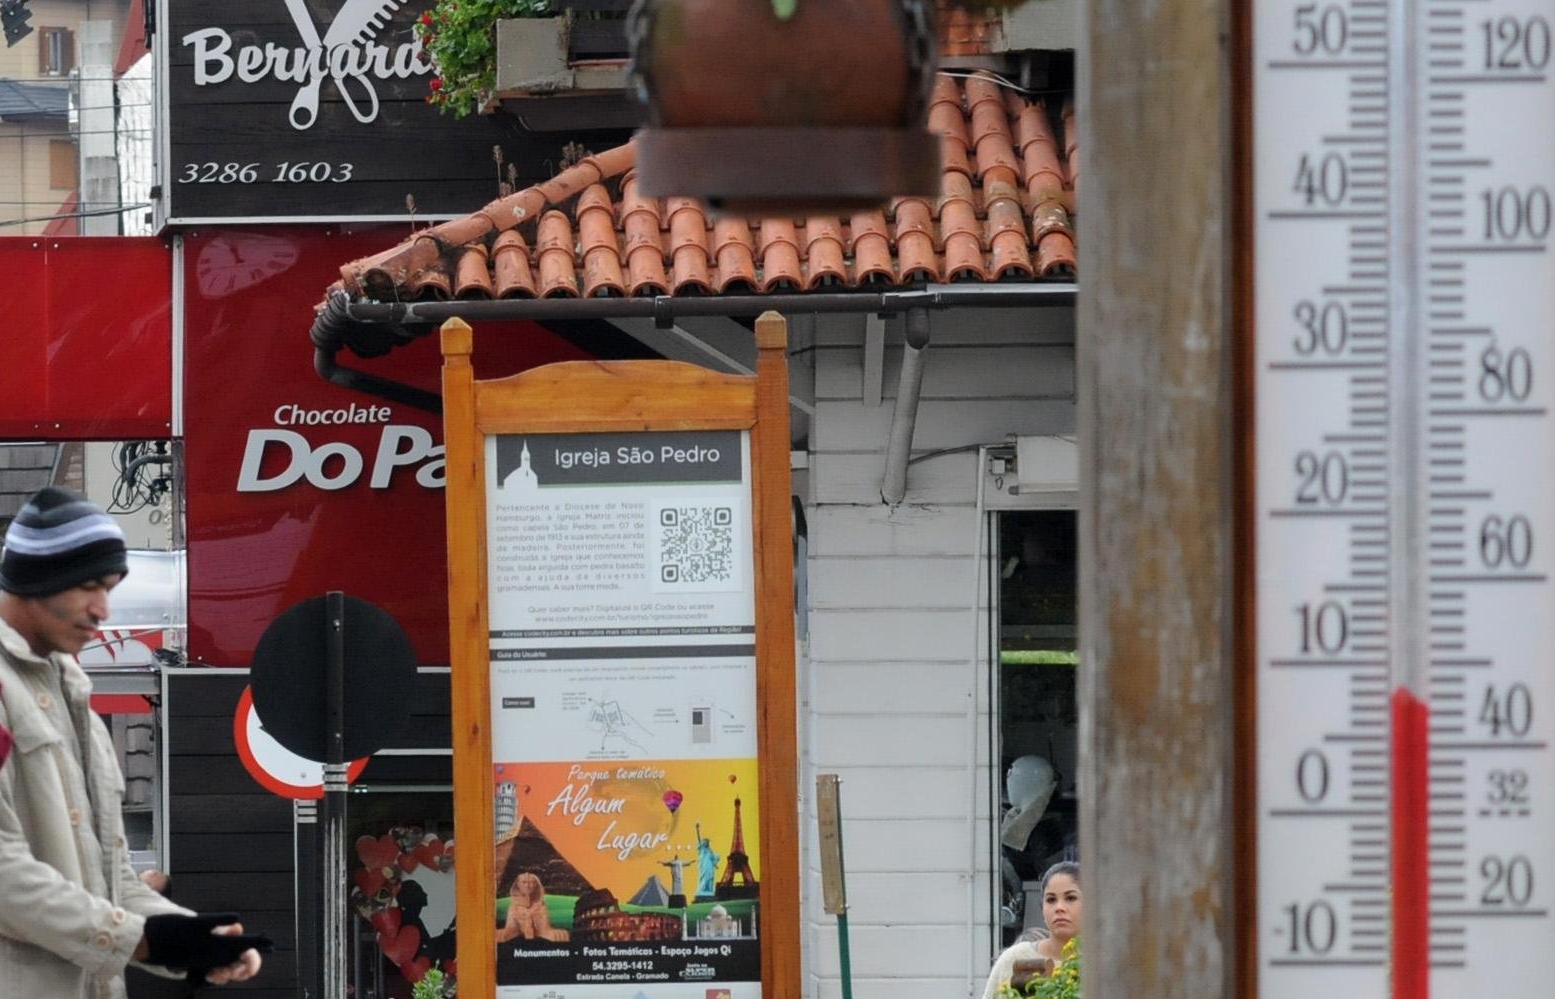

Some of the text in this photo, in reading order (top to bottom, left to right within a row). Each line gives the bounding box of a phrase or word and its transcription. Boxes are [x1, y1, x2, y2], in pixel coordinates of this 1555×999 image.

[182, 24, 442, 86] Bernard
[1292, 4, 1348, 56] 50
[1481, 16, 1551, 71] 120
[178, 162, 353, 184] 3286 1603
[1292, 154, 1348, 207] 40
[1481, 186, 1551, 241] 100
[1292, 301, 1348, 355] 30
[1478, 347, 1532, 402] 80
[273, 402, 391, 425] Chocolate
[236, 428, 364, 492] Do
[555, 445, 720, 469] Igreja São Pedro
[1295, 451, 1348, 504] 20
[1479, 515, 1532, 569] 60
[1294, 600, 1348, 655] 10
[1479, 684, 1533, 737] 40
[567, 764, 666, 785] Parque temático
[1295, 748, 1329, 804] 0
[1487, 769, 1528, 804] 32
[546, 783, 626, 826] Algum
[1479, 856, 1533, 907] 20
[513, 948, 570, 958] Monumentos
[583, 947, 607, 957] Fotos
[608, 946, 653, 957] Temáticas
[661, 945, 692, 957] Espaço
[693, 945, 719, 956] Jogos
[1273, 902, 1336, 955] -10
[576, 973, 604, 981] Estrada
[636, 971, 670, 980] Gramado
[592, 961, 653, 971] 54.3295-1412
